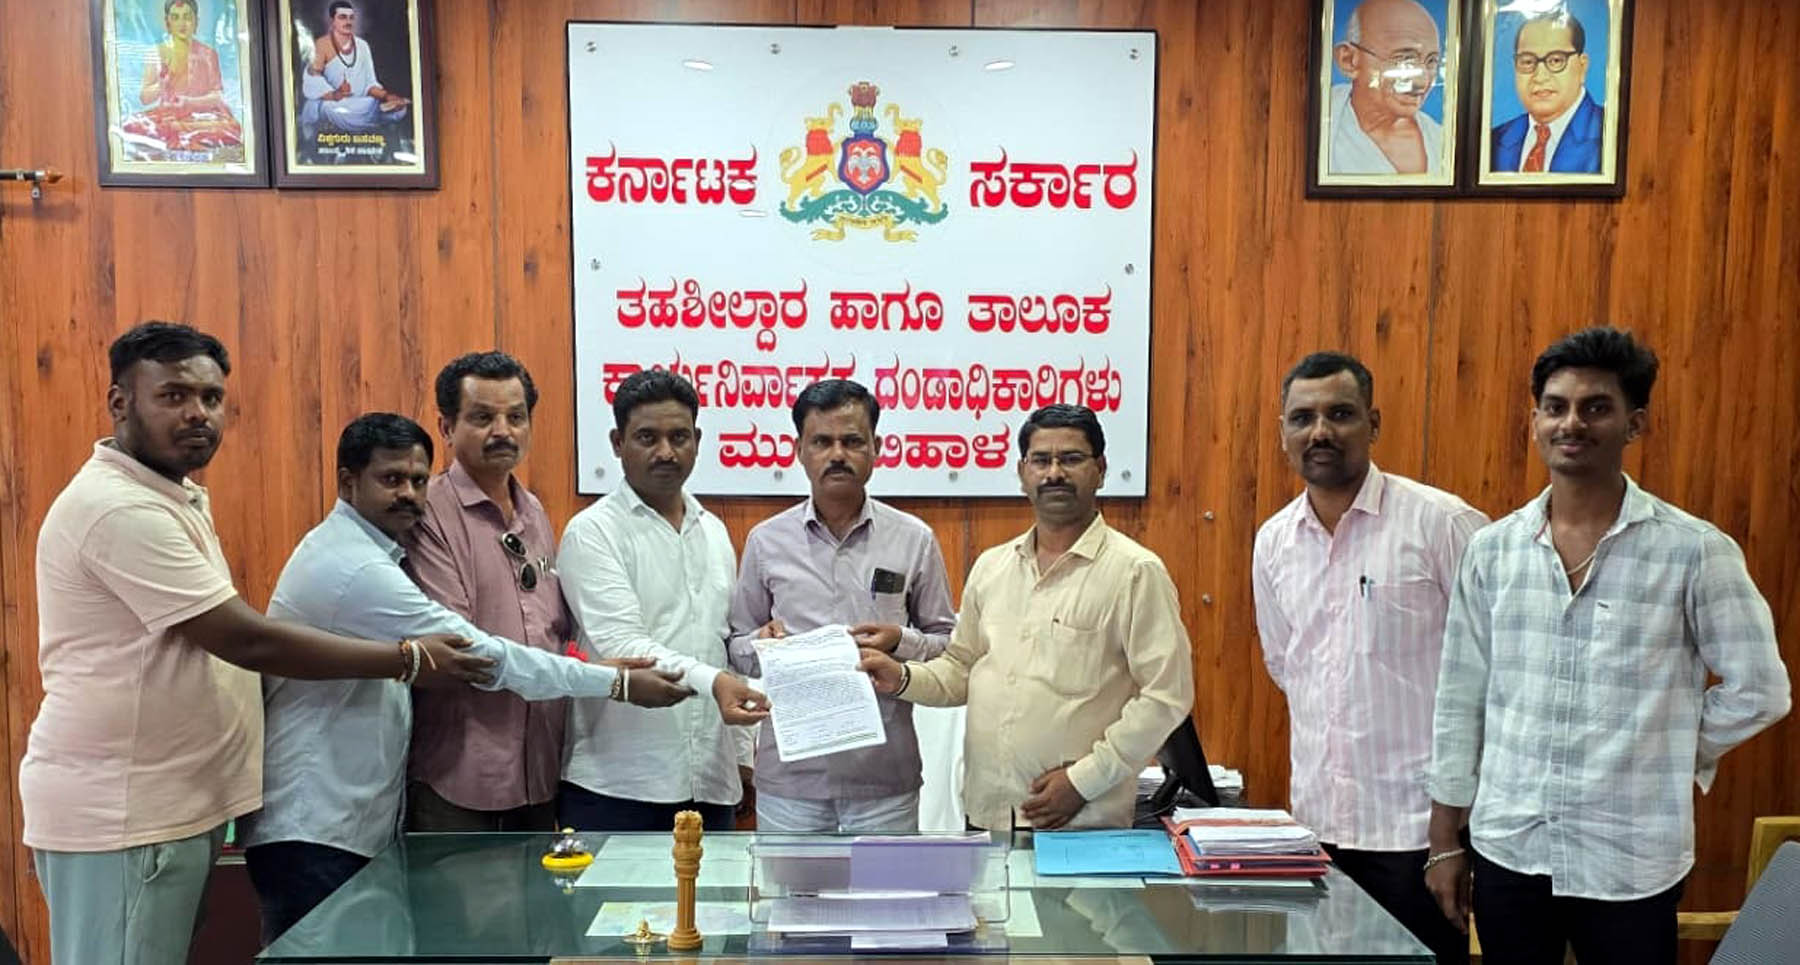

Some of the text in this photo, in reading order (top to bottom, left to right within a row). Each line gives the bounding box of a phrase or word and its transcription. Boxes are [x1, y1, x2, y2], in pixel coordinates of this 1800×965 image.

[585, 140, 1138, 210] ಕರ್ನಾಟಕ ಸರ್ಕಾರ
[616, 276, 1113, 351] ತಹಶೀಲ್ದಾರ ಹಾಗೂ ತಾಲೂಕ
[874, 351, 1123, 421] ದಂಡಾಧಿಕಾರಿಗಳು
